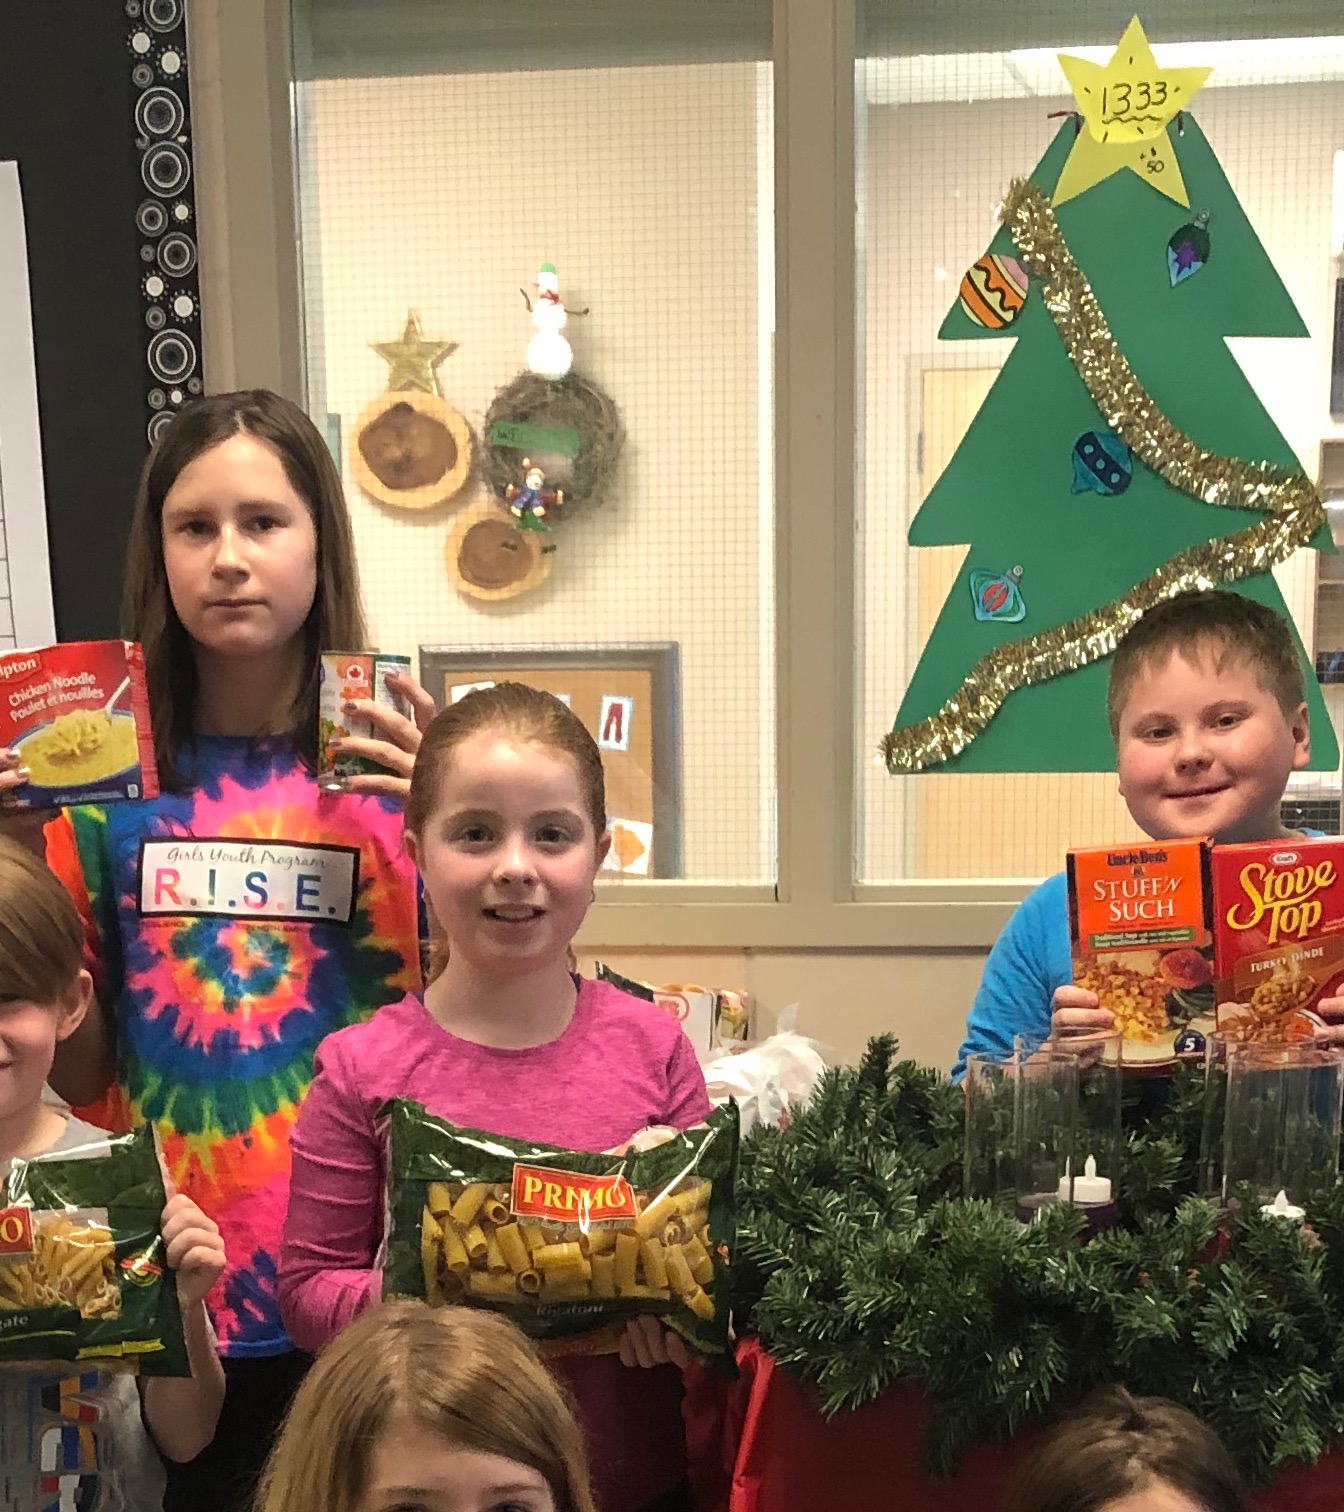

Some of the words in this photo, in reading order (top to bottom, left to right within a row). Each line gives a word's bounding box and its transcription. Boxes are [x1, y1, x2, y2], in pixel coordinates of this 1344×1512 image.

[1102, 81, 1167, 116] 1333
[8, 682, 51, 706] Chicken
[52, 672, 96, 688] Noodle
[10, 698, 46, 722] Poulet
[47, 695, 58, 706] et
[60, 687, 104, 701] nouilles
[167, 845, 204, 861] Girls
[209, 847, 256, 866] Youth
[260, 849, 326, 869] Program
[1109, 899, 1174, 921] SUCH
[1227, 861, 1337, 930] Stove
[1263, 900, 1322, 944] Top
[1251, 958, 1287, 973] TURKEY
[1183, 1037, 1196, 1052] 5
[523, 1176, 626, 1210] PRIMO
